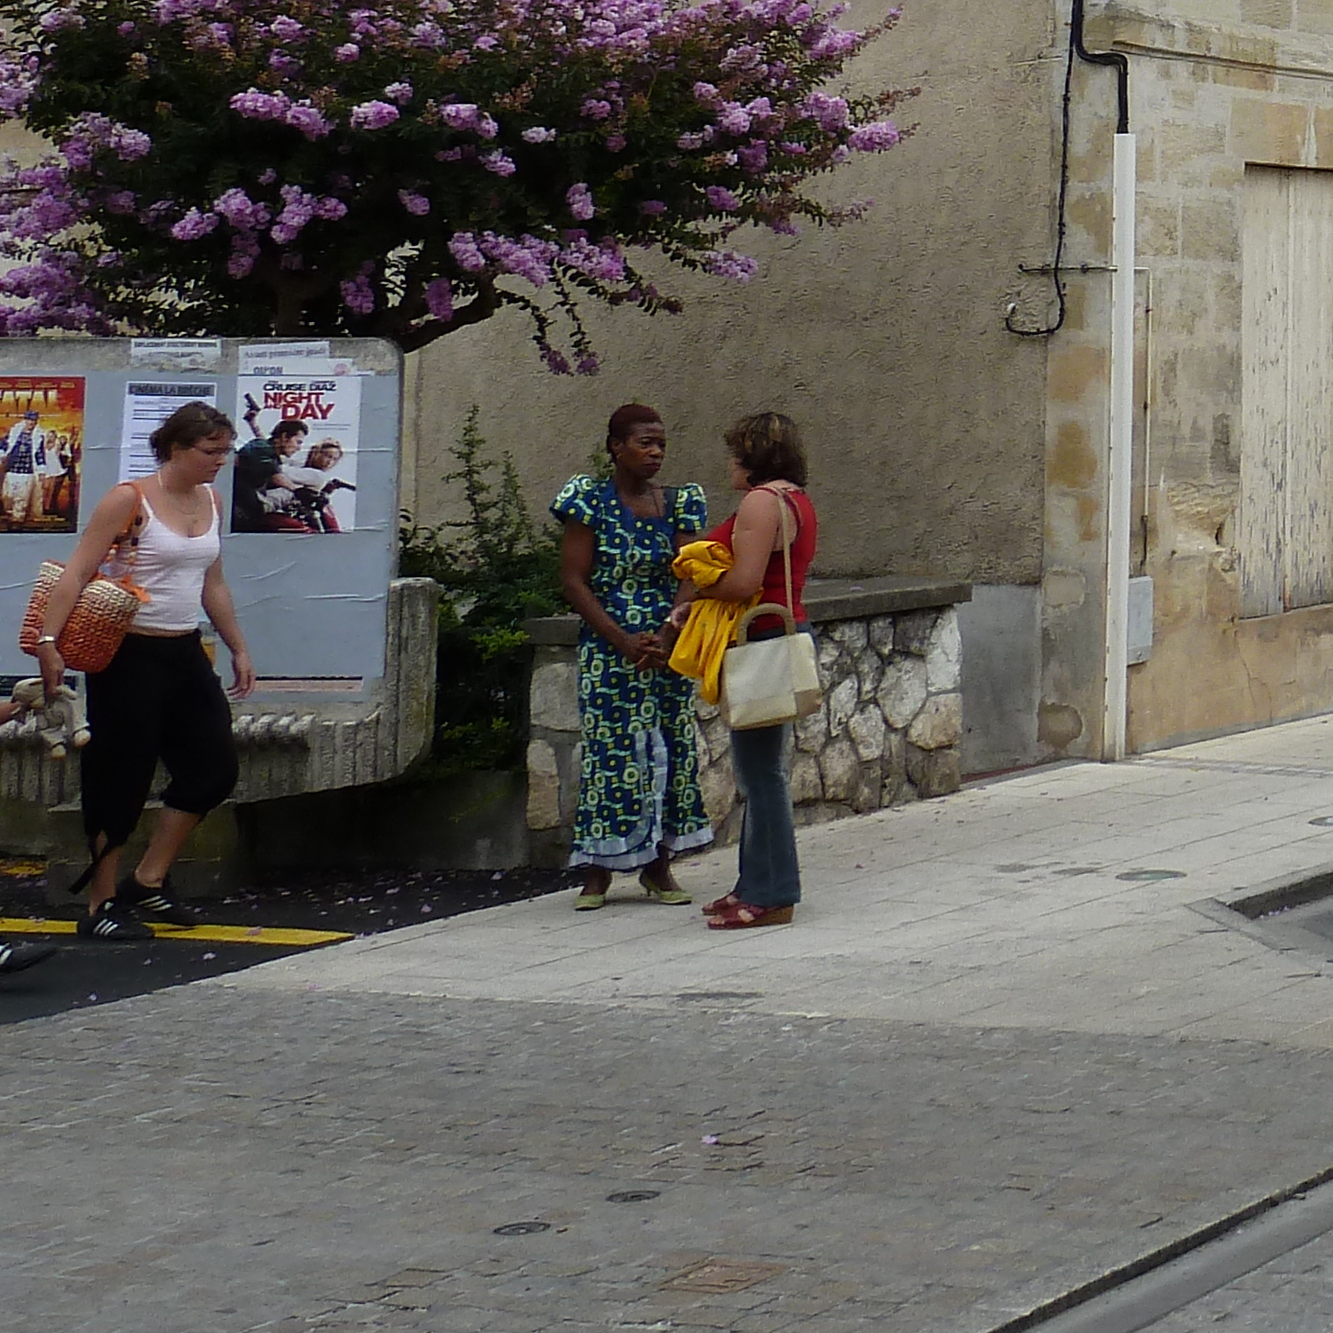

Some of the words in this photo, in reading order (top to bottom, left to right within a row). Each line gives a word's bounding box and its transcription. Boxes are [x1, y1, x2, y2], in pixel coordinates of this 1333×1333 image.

[263, 383, 306, 391] CRUISE
[309, 383, 336, 391] DIAZ
[264, 392, 324, 404] NIGHT
[282, 404, 335, 419] DAY
